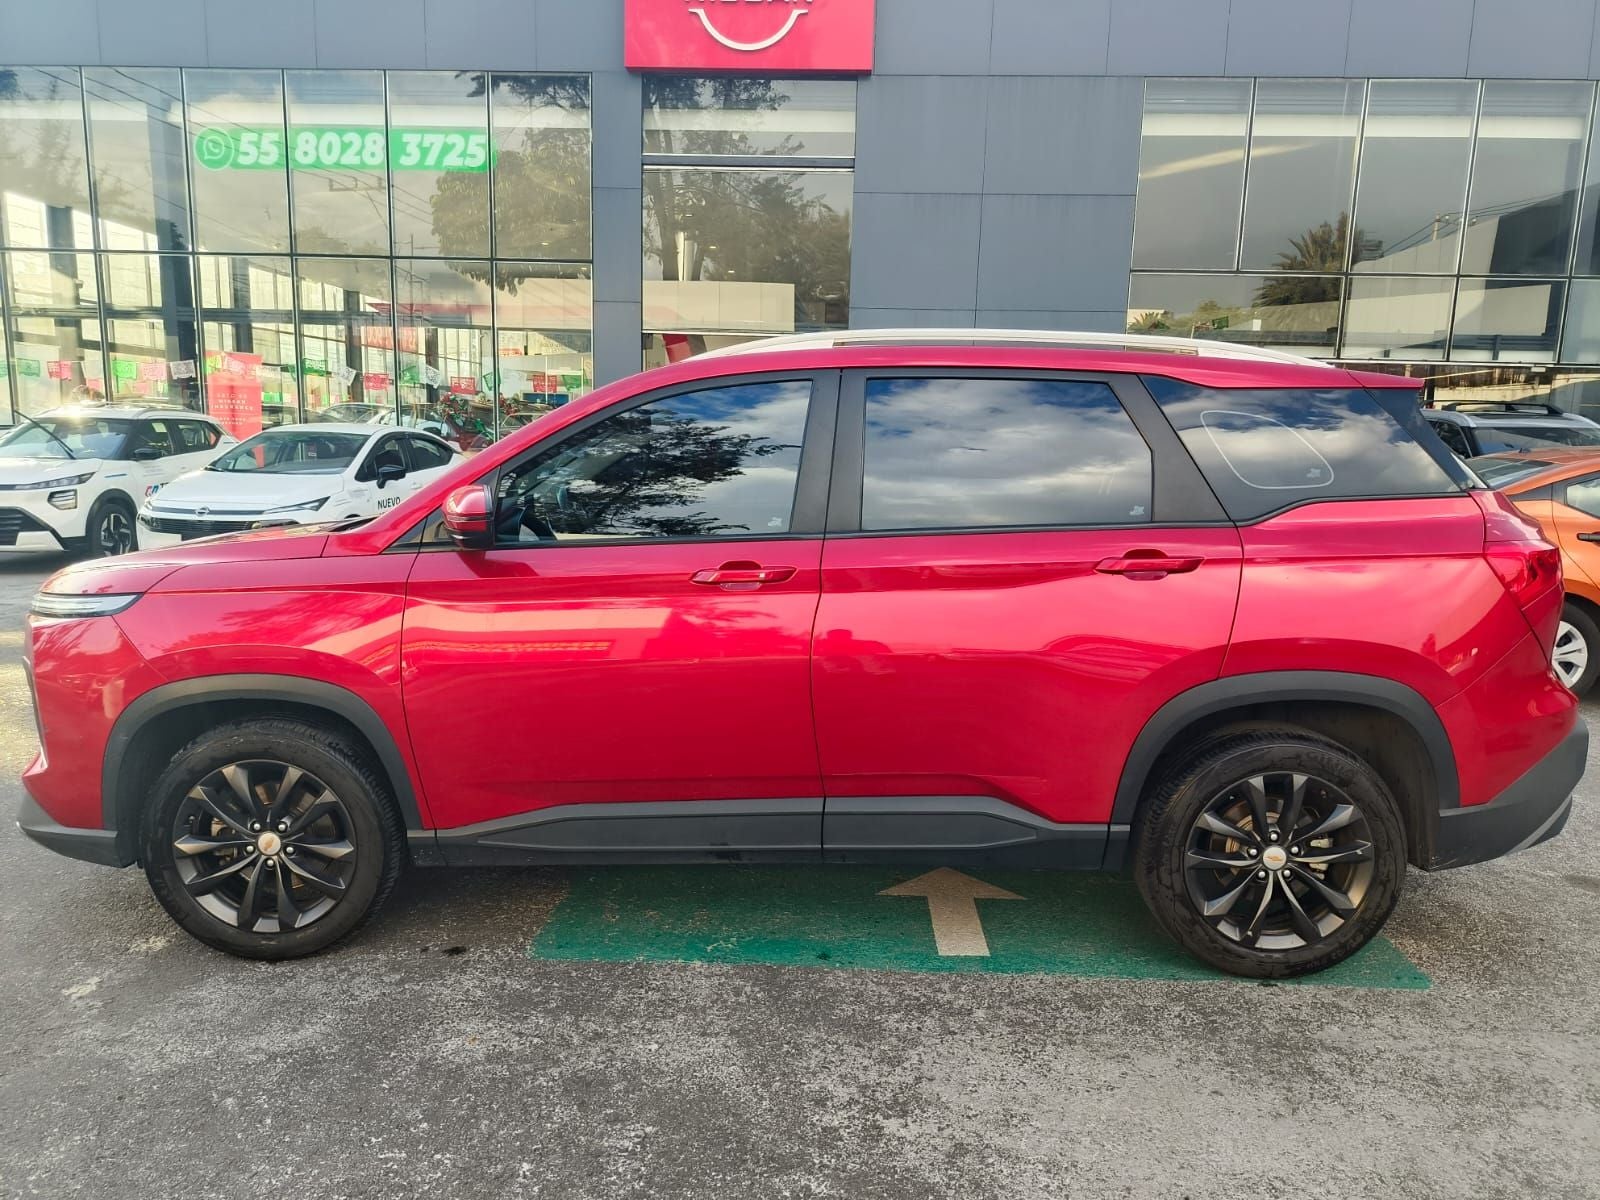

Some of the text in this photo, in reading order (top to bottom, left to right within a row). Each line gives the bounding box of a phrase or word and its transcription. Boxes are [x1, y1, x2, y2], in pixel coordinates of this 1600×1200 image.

[236, 131, 487, 168] 55 8028 3725
[377, 497, 400, 510] NUEVO
